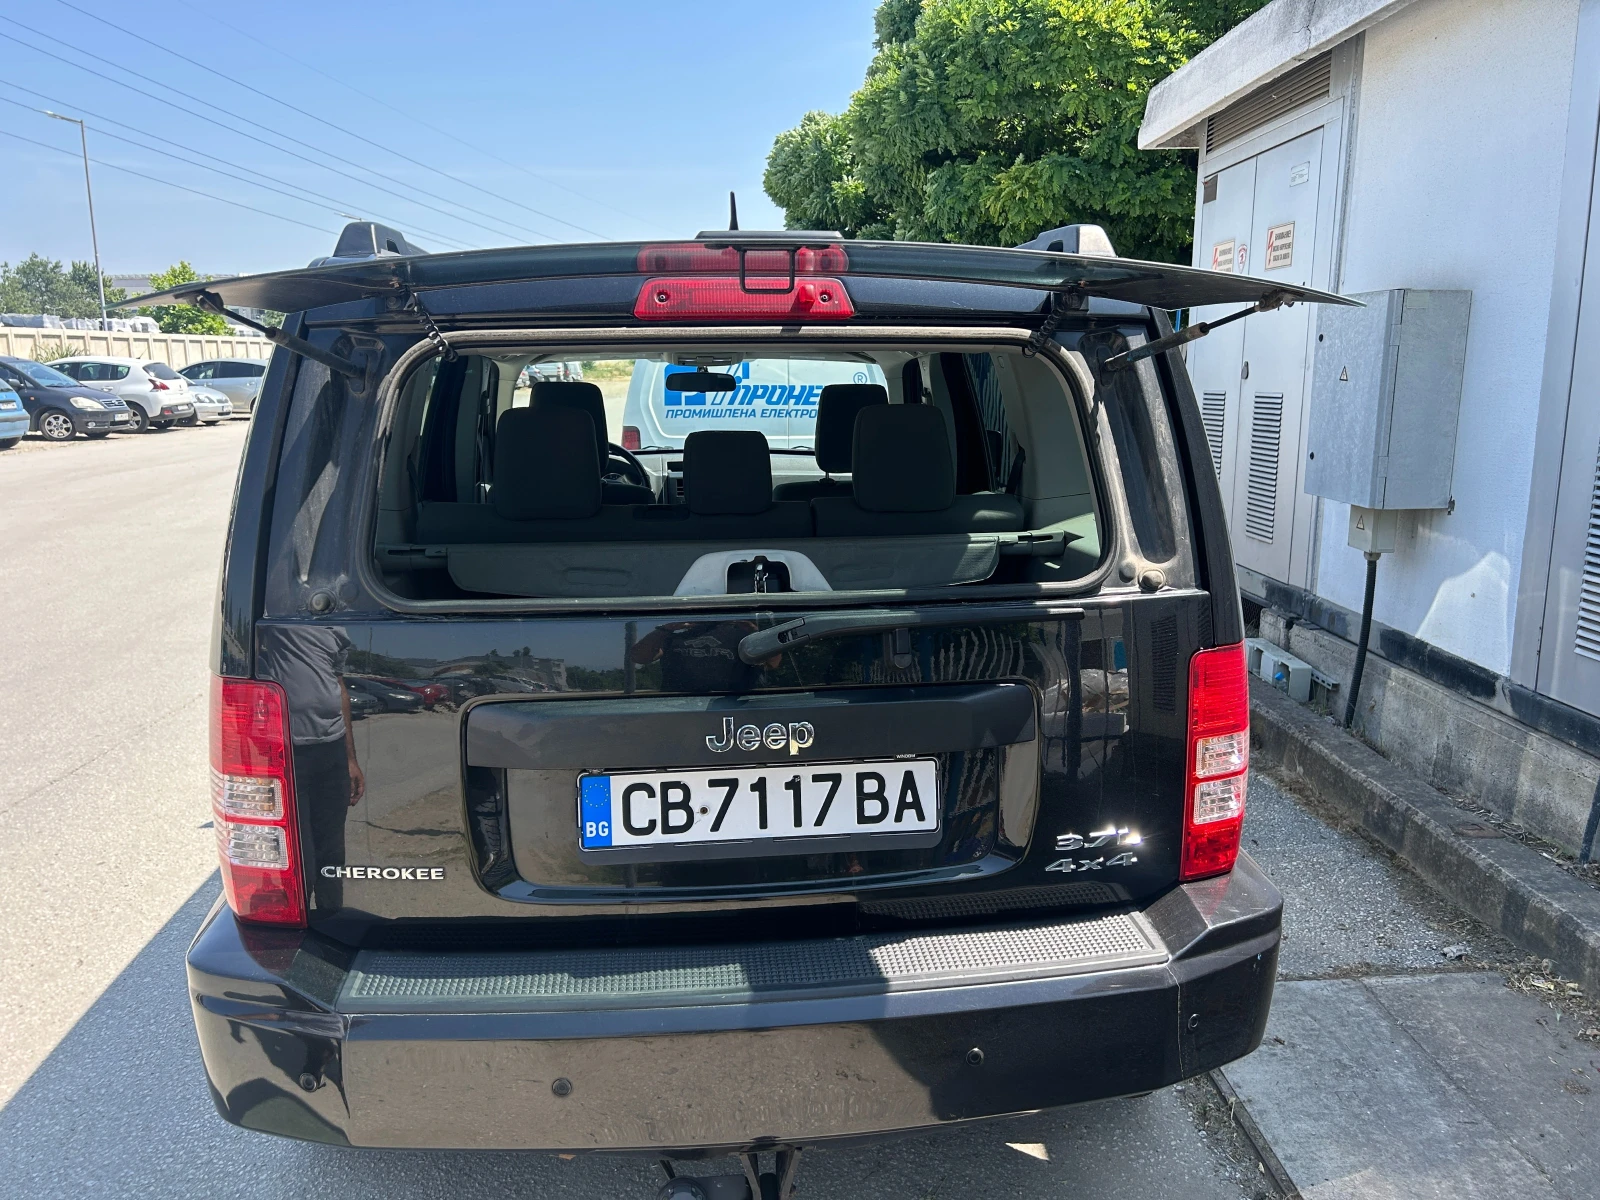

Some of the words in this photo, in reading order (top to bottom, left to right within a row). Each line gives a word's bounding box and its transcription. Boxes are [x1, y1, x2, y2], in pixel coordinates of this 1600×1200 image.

[727, 384, 823, 406] ПРОНЕ
[665, 408, 757, 419] ПРОМИШЛЕНА
[760, 408, 818, 419] ЕЛЕКТРО
[706, 716, 815, 756] Jeep
[621, 781, 695, 836] CB
[708, 773, 842, 832] 7117
[856, 770, 926, 825] BA
[585, 821, 609, 838] BG
[320, 865, 445, 880] CHEROKEE
[1045, 852, 1138, 873] 4x4
